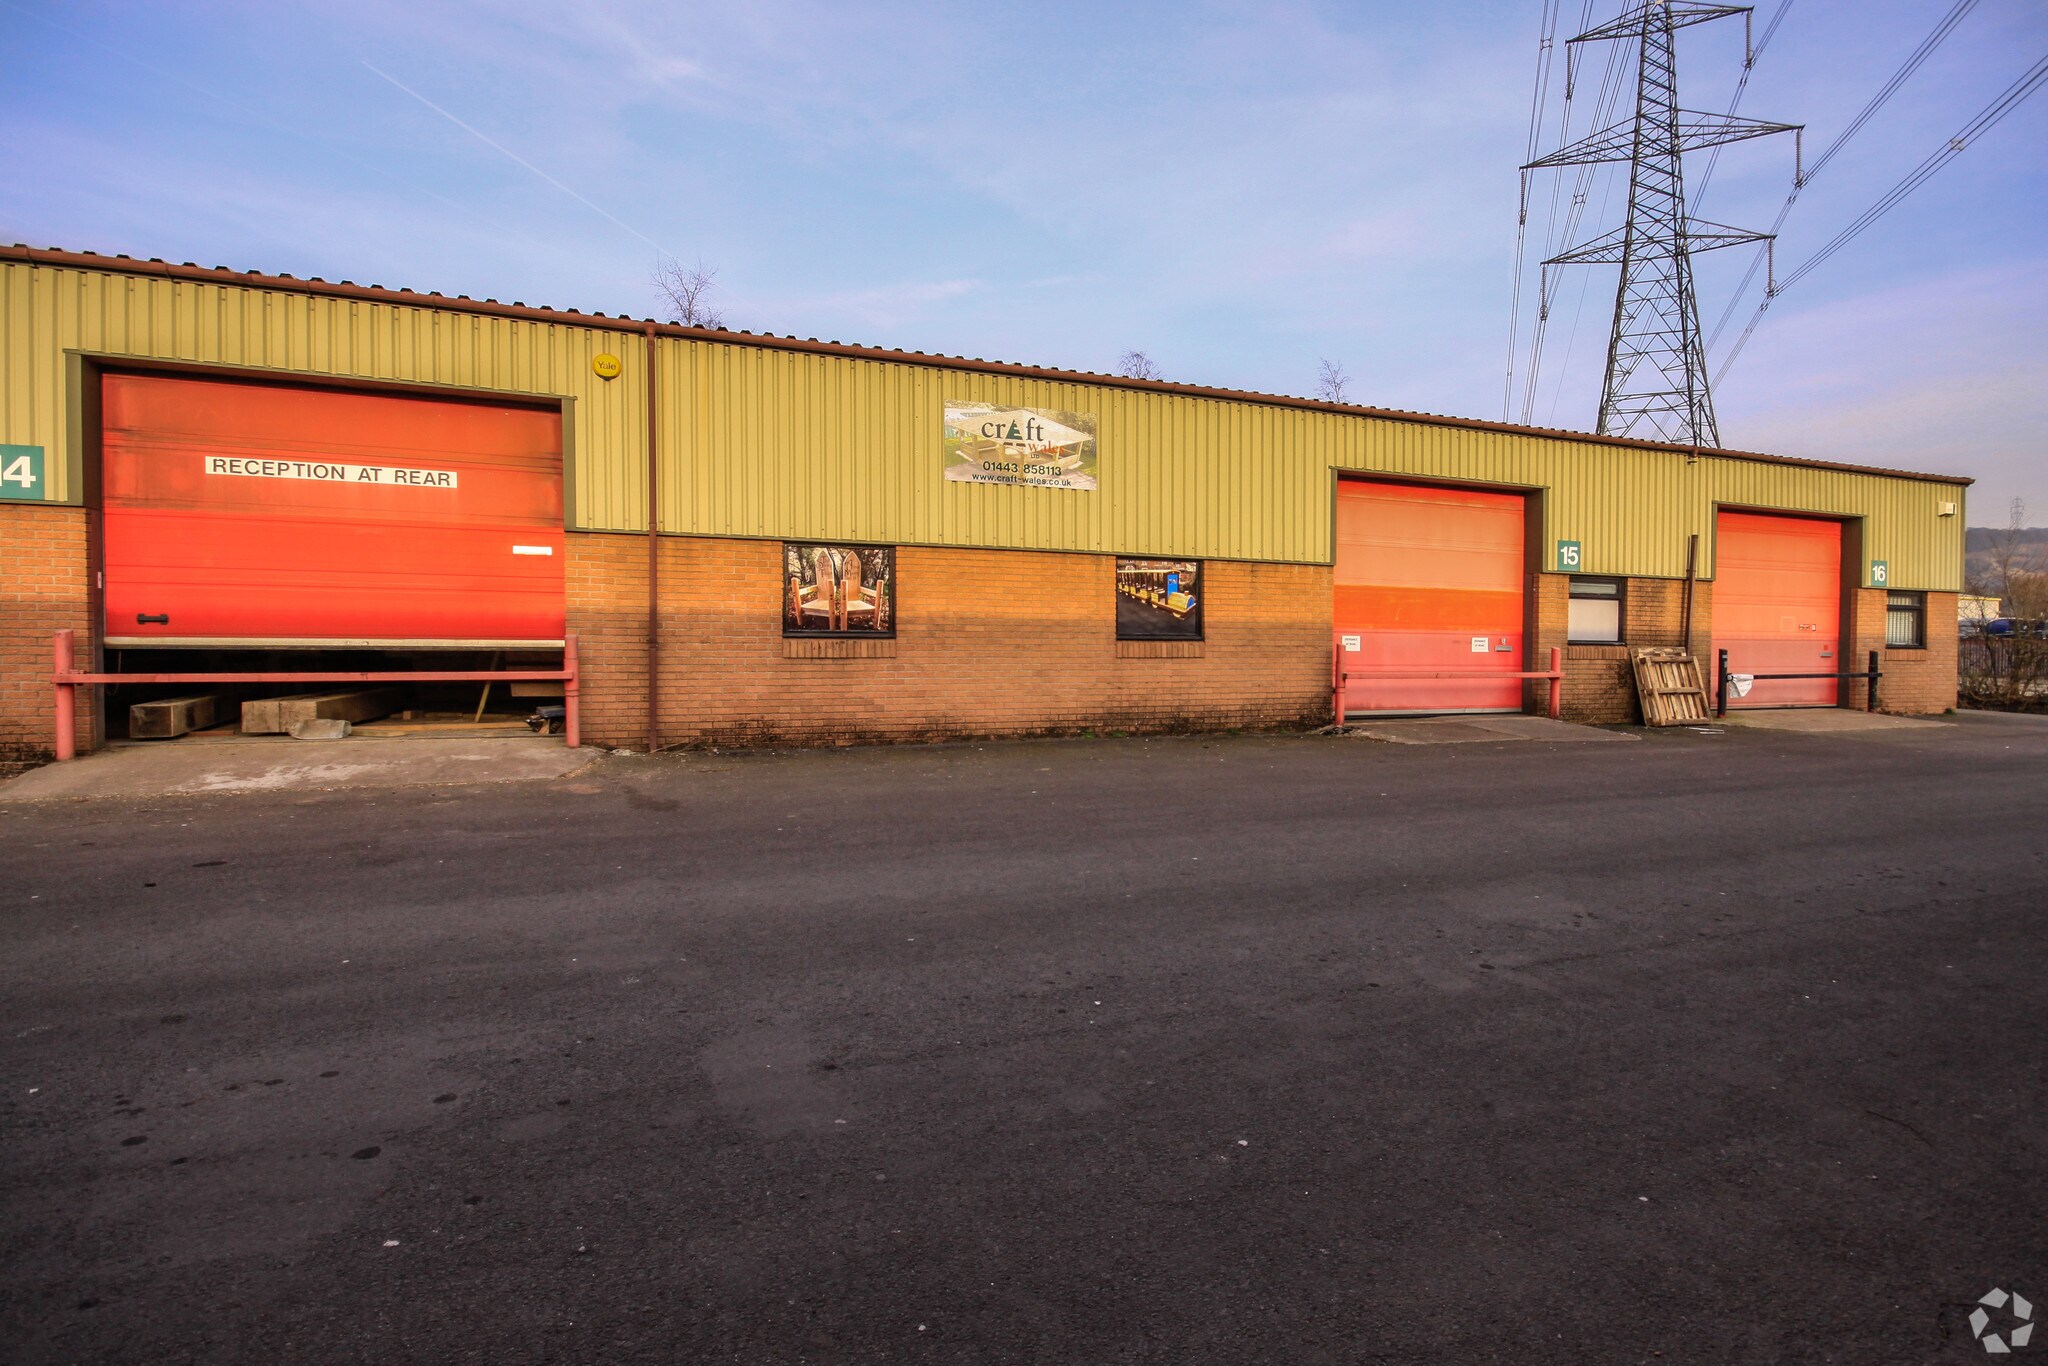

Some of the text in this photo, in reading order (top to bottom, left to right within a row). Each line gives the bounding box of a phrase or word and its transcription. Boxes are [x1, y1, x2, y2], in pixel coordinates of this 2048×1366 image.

[597, 361, 617, 370] Yale
[1028, 440, 1065, 454] wales
[0, 455, 36, 488] 4
[213, 458, 450, 486] RECEPTION AT REAR
[982, 461, 1062, 476] 01443 858113
[972, 473, 1072, 487] www.craft-wales.co.uk
[1560, 546, 1579, 566] 15
[1872, 565, 1886, 581] 16
